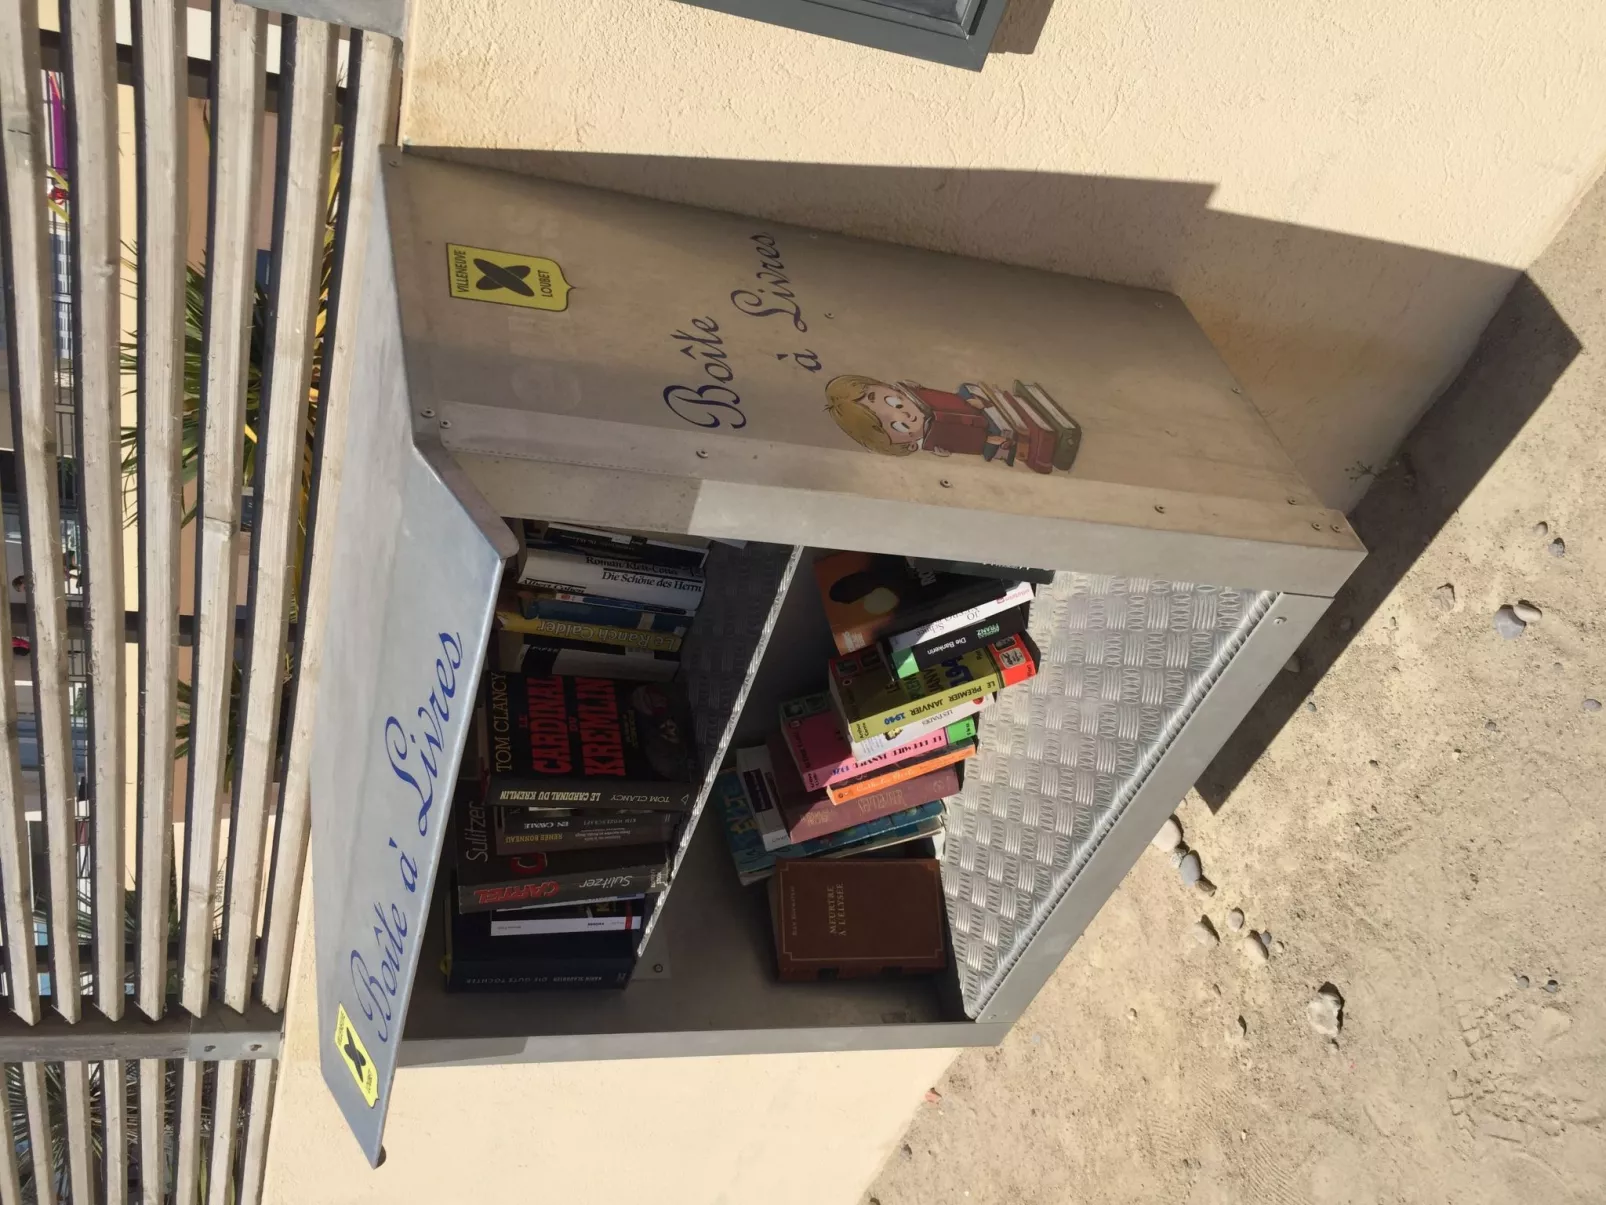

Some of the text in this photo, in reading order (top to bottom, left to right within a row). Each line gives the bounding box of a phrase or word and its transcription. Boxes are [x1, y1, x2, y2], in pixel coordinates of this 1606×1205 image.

[455, 249, 469, 293] VILLENEUVE
[540, 269, 554, 298] LOUBET
[730, 232, 808, 333] Livres
[663, 315, 747, 429] Boîte
[601, 570, 703, 592] Die Schöne des Herrn
[537, 618, 675, 651] Le Ranch Calder
[927, 636, 967, 655] Die Bankerin
[976, 623, 1000, 636] FRANZ
[518, 714, 528, 729] LE
[884, 680, 996, 725] LE PREMIER JANVIER 1940
[491, 672, 513, 772] TOM CLANCY
[526, 675, 572, 774] CARDINAL
[574, 676, 626, 777] KREMLIN
[500, 790, 601, 801] LE CARDINAL DU KREMLIN
[610, 794, 671, 803] TOM CLANCY
[350, 901, 408, 1043] Boîte
[384, 631, 463, 837] Livres
[464, 800, 488, 862] Sulitzer
[473, 880, 561, 905] CARTEL
[578, 875, 633, 889] Sulitzer
[826, 886, 838, 936] MEURTRE
